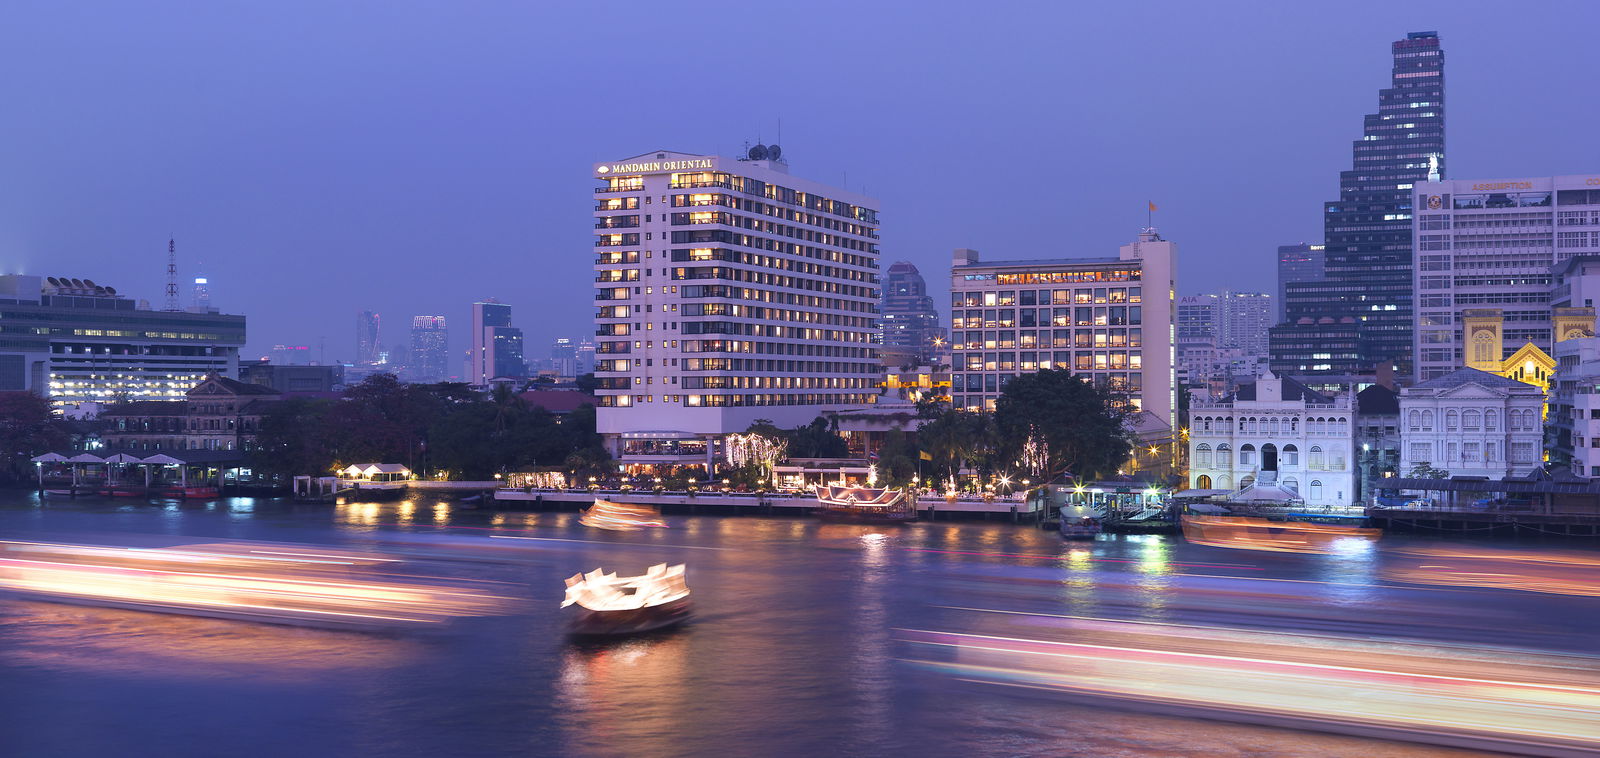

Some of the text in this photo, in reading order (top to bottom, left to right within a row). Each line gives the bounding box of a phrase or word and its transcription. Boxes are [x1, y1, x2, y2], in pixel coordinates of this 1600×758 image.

[613, 159, 712, 173] MANDARIN ORIENTAL
[1472, 181, 1532, 190] ASSUMPTION
